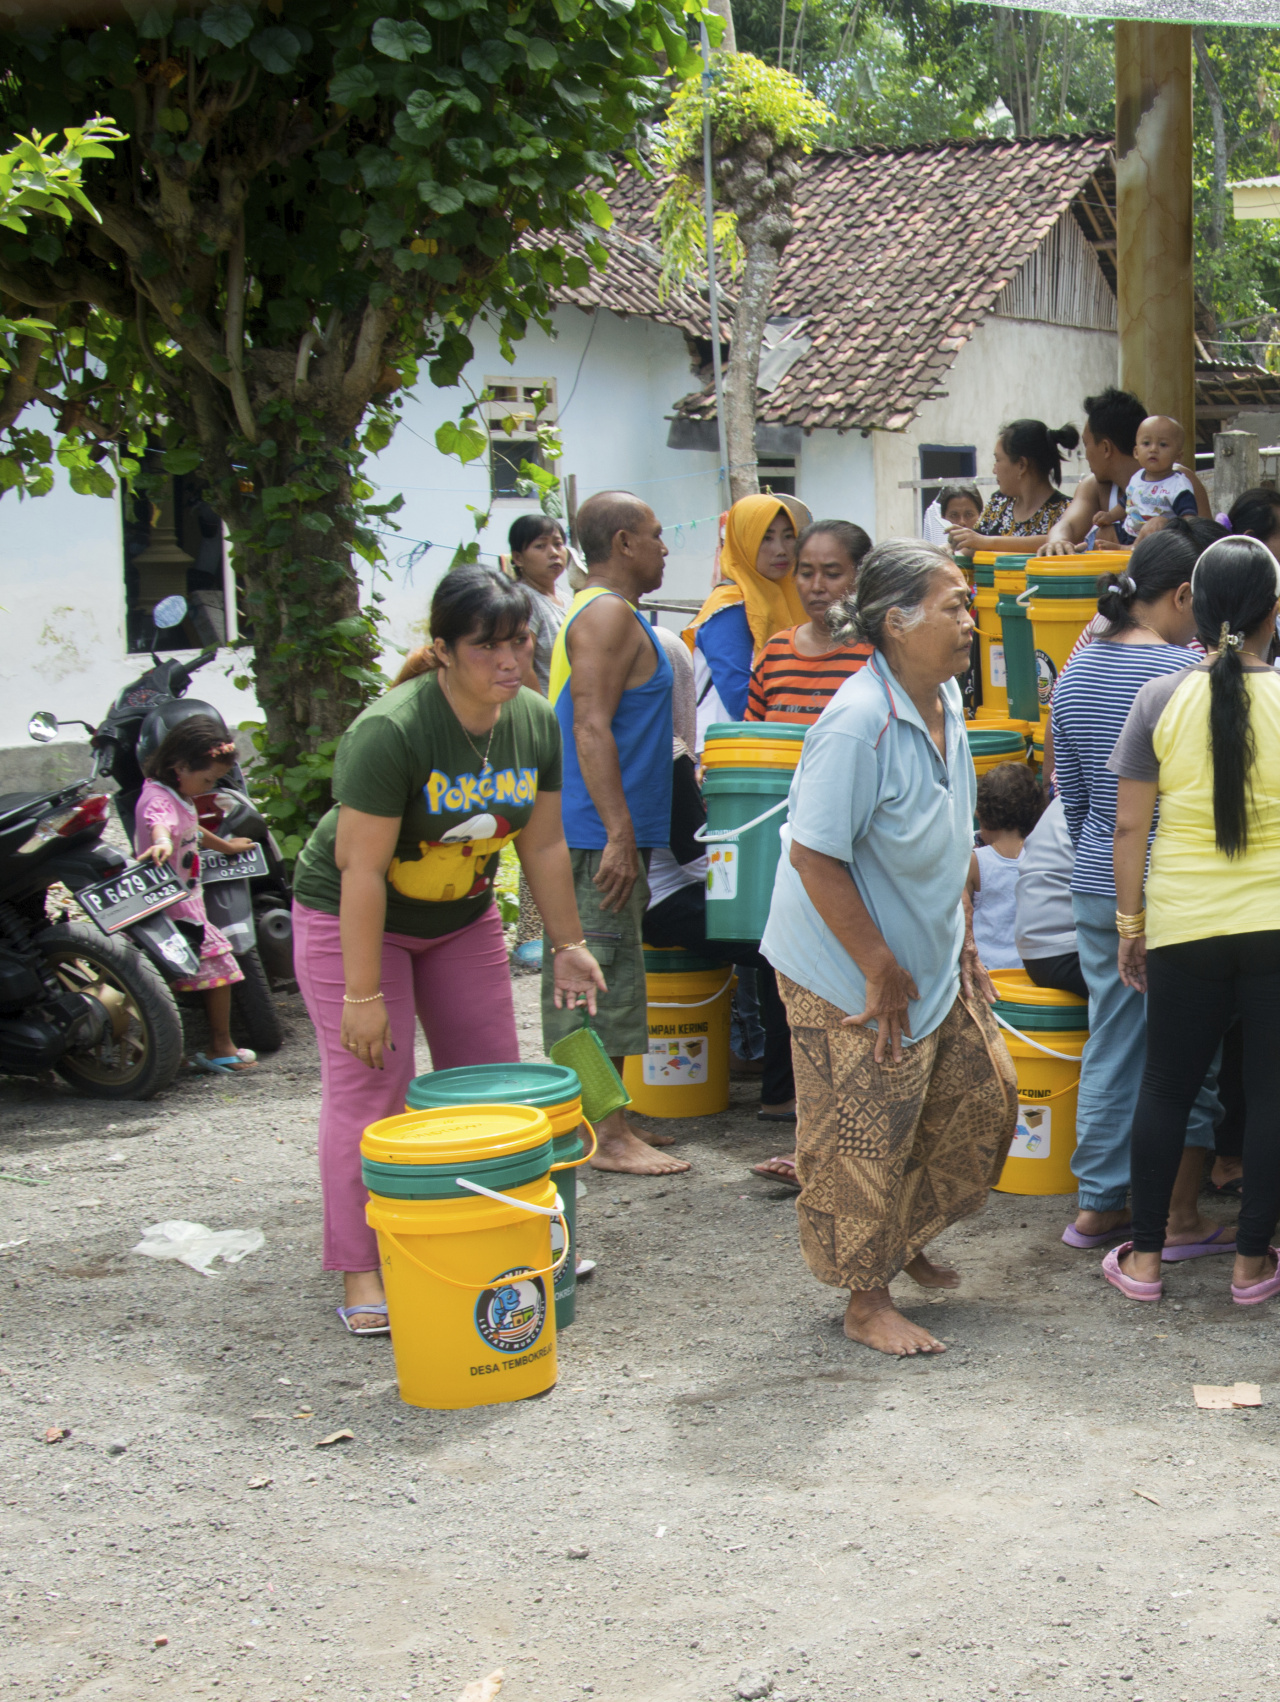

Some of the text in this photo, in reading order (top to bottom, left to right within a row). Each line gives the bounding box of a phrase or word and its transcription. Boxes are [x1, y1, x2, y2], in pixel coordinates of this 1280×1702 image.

[87, 892, 102, 911] P
[104, 875, 147, 905] 6479
[678, 1021, 709, 1035] KERING
[478, 1318, 510, 1349] LESTARI
[470, 1342, 553, 1377] DESA TEMBOKREJO
